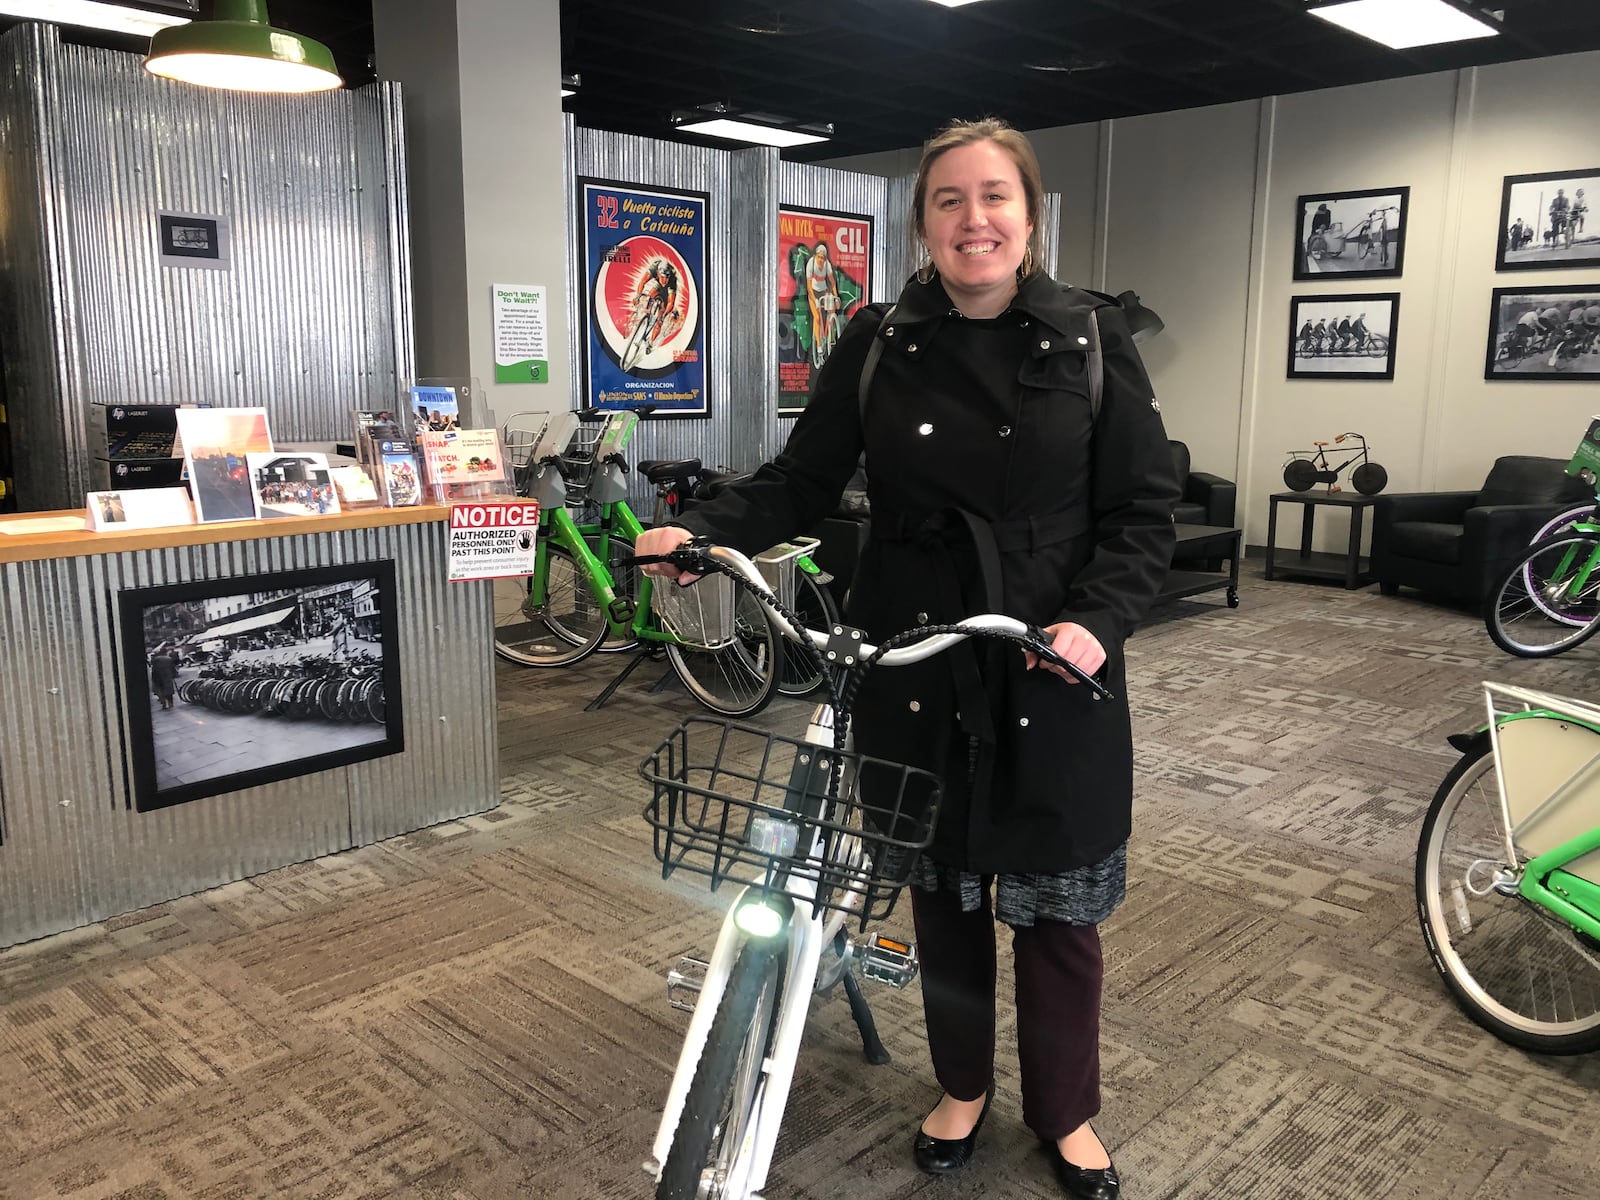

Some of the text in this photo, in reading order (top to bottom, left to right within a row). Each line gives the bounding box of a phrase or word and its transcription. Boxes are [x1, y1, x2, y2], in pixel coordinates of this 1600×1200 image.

[597, 195, 695, 229] 32 Vuelta ciclista
[623, 216, 695, 236] a Cataluña
[835, 227, 865, 254] CIL
[497, 290, 540, 299] Don't Want
[418, 392, 454, 403] DOWNTOWN
[633, 392, 646, 400] SANS
[112, 407, 125, 420] hp
[116, 464, 128, 476] hp
[453, 506, 537, 527] NOTICE
[452, 530, 517, 541] AUTHORIZED
[452, 540, 495, 549] PERSONNEL
[451, 547, 516, 557] PAST THIS POINT
